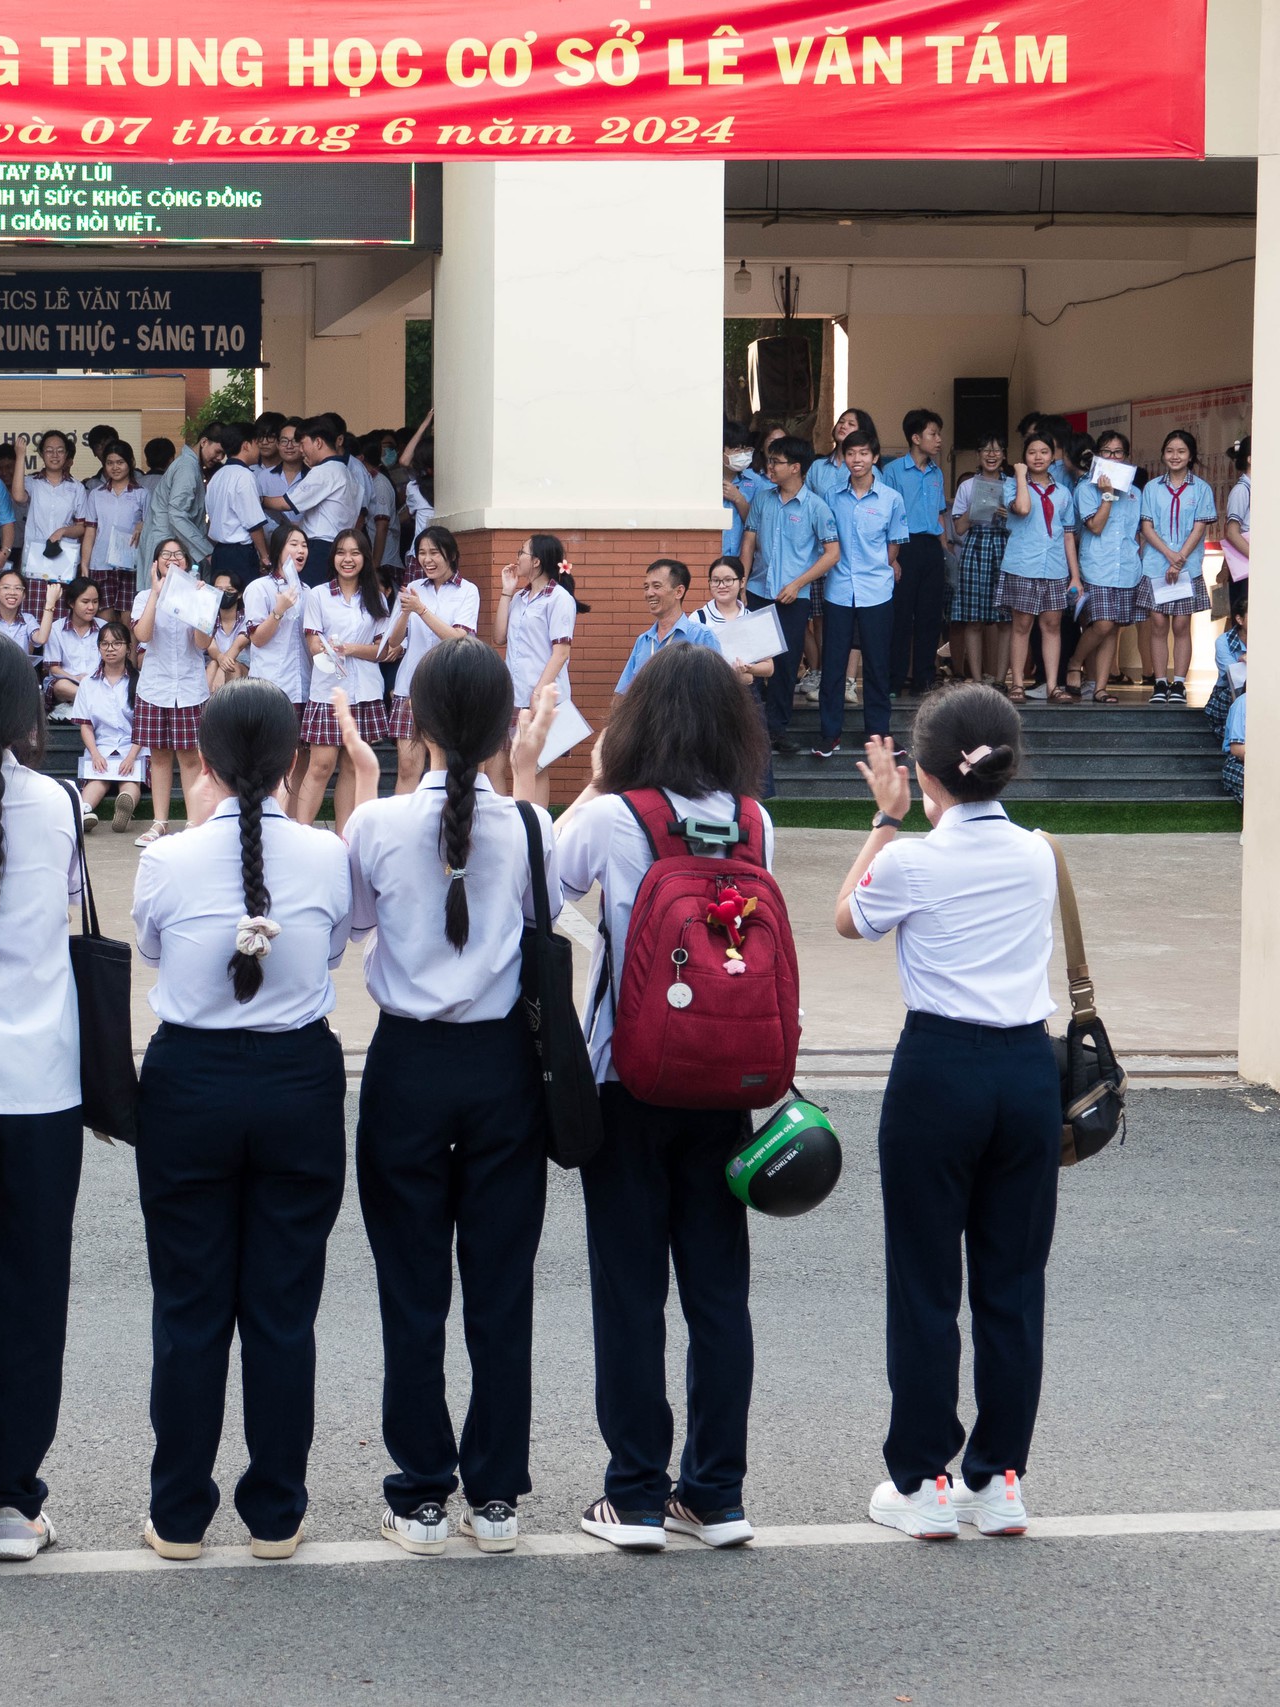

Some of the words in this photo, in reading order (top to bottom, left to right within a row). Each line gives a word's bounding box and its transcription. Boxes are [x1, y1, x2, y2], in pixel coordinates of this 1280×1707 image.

[40, 37, 262, 86] TRUNG
[288, 37, 422, 97] HỌC
[446, 31, 537, 88] CƠ
[554, 19, 645, 86] SỞ
[668, 26, 744, 85] LÊ
[773, 26, 902, 84] VĂN
[925, 22, 1067, 83] TÁM
[82, 117, 151, 144] 07
[173, 117, 359, 151] tháng
[383, 118, 415, 144] 6
[438, 118, 574, 144] năm
[596, 117, 734, 143] 2024
[20, 184, 39, 206] VÌ
[45, 184, 87, 206] SỨC
[148, 187, 202, 209] CỘNG
[11, 209, 71, 230] GIỐNG
[77, 210, 108, 231] NÒI
[114, 212, 162, 234] VIỆT.
[45, 286, 70, 309] LÊ
[78, 287, 119, 310] VĂN
[127, 285, 171, 310] TÁM
[56, 321, 115, 357] THỰC
[137, 319, 194, 351] SÁNG
[202, 325, 245, 357] TẠO
[764, 1131, 785, 1149] WEBSITE
